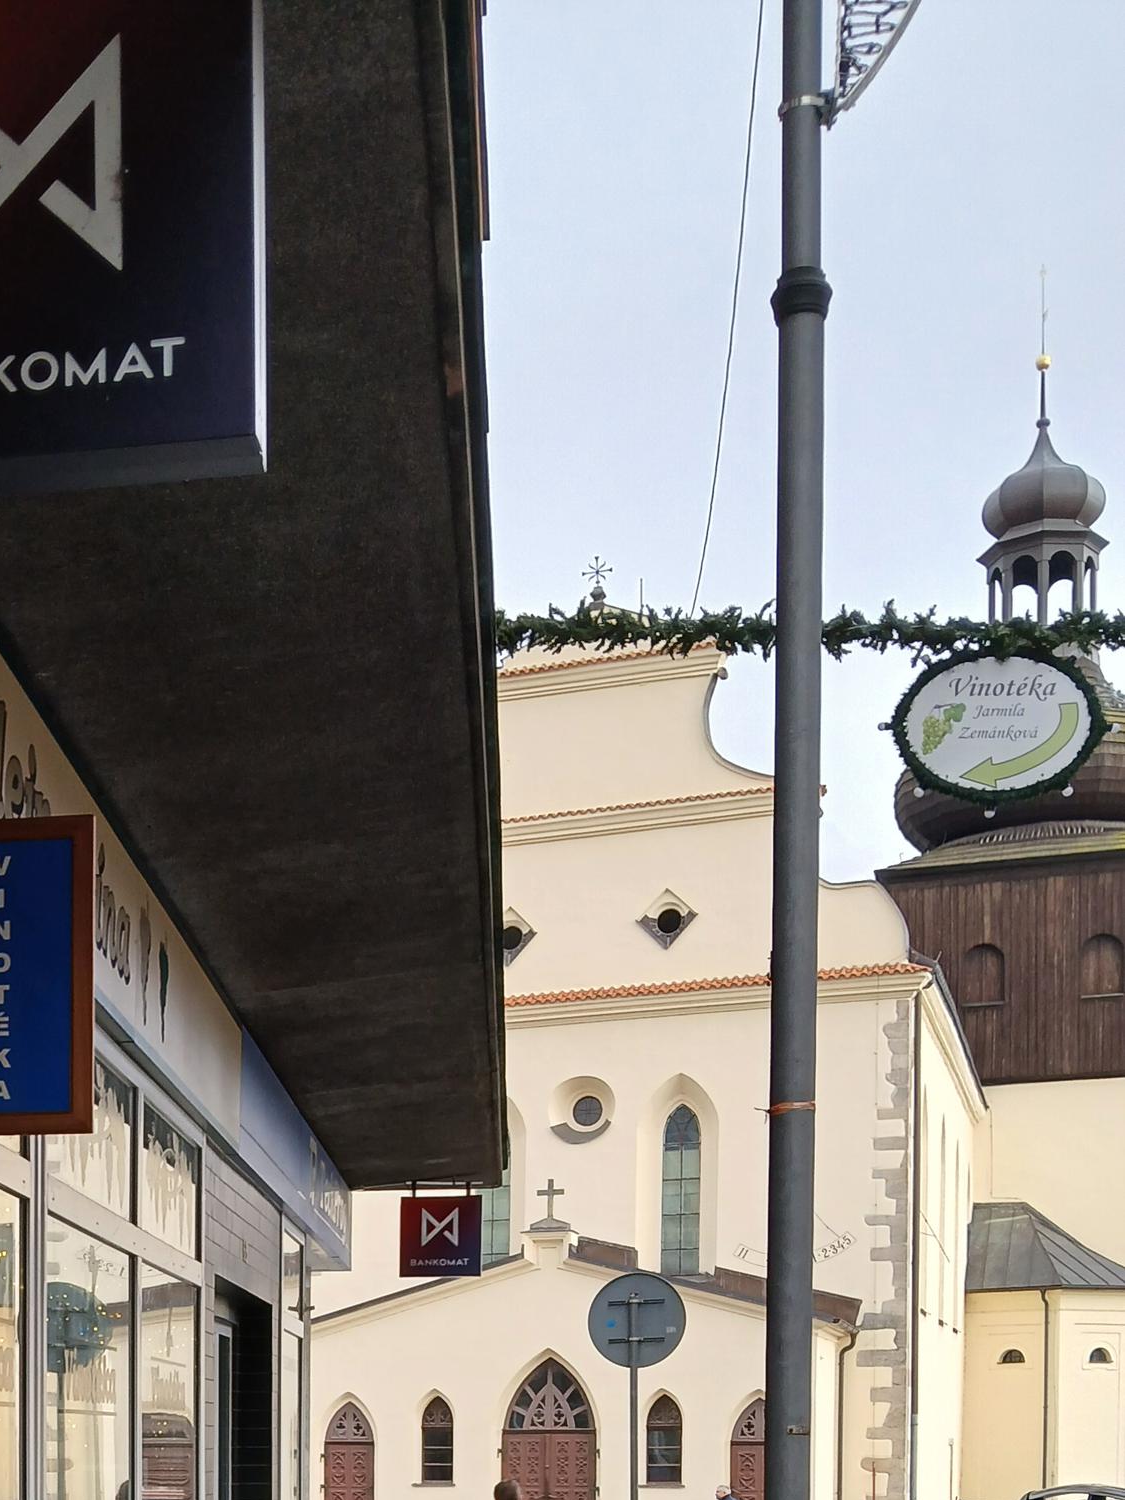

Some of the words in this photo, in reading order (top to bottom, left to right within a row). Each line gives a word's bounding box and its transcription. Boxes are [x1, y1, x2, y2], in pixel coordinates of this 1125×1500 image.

[948, 674, 1058, 702] Vinotéka
[973, 702, 1025, 719] Jarmila
[958, 725, 1038, 741] Zemánková
[410, 1257, 470, 1267] BANKOMAT
